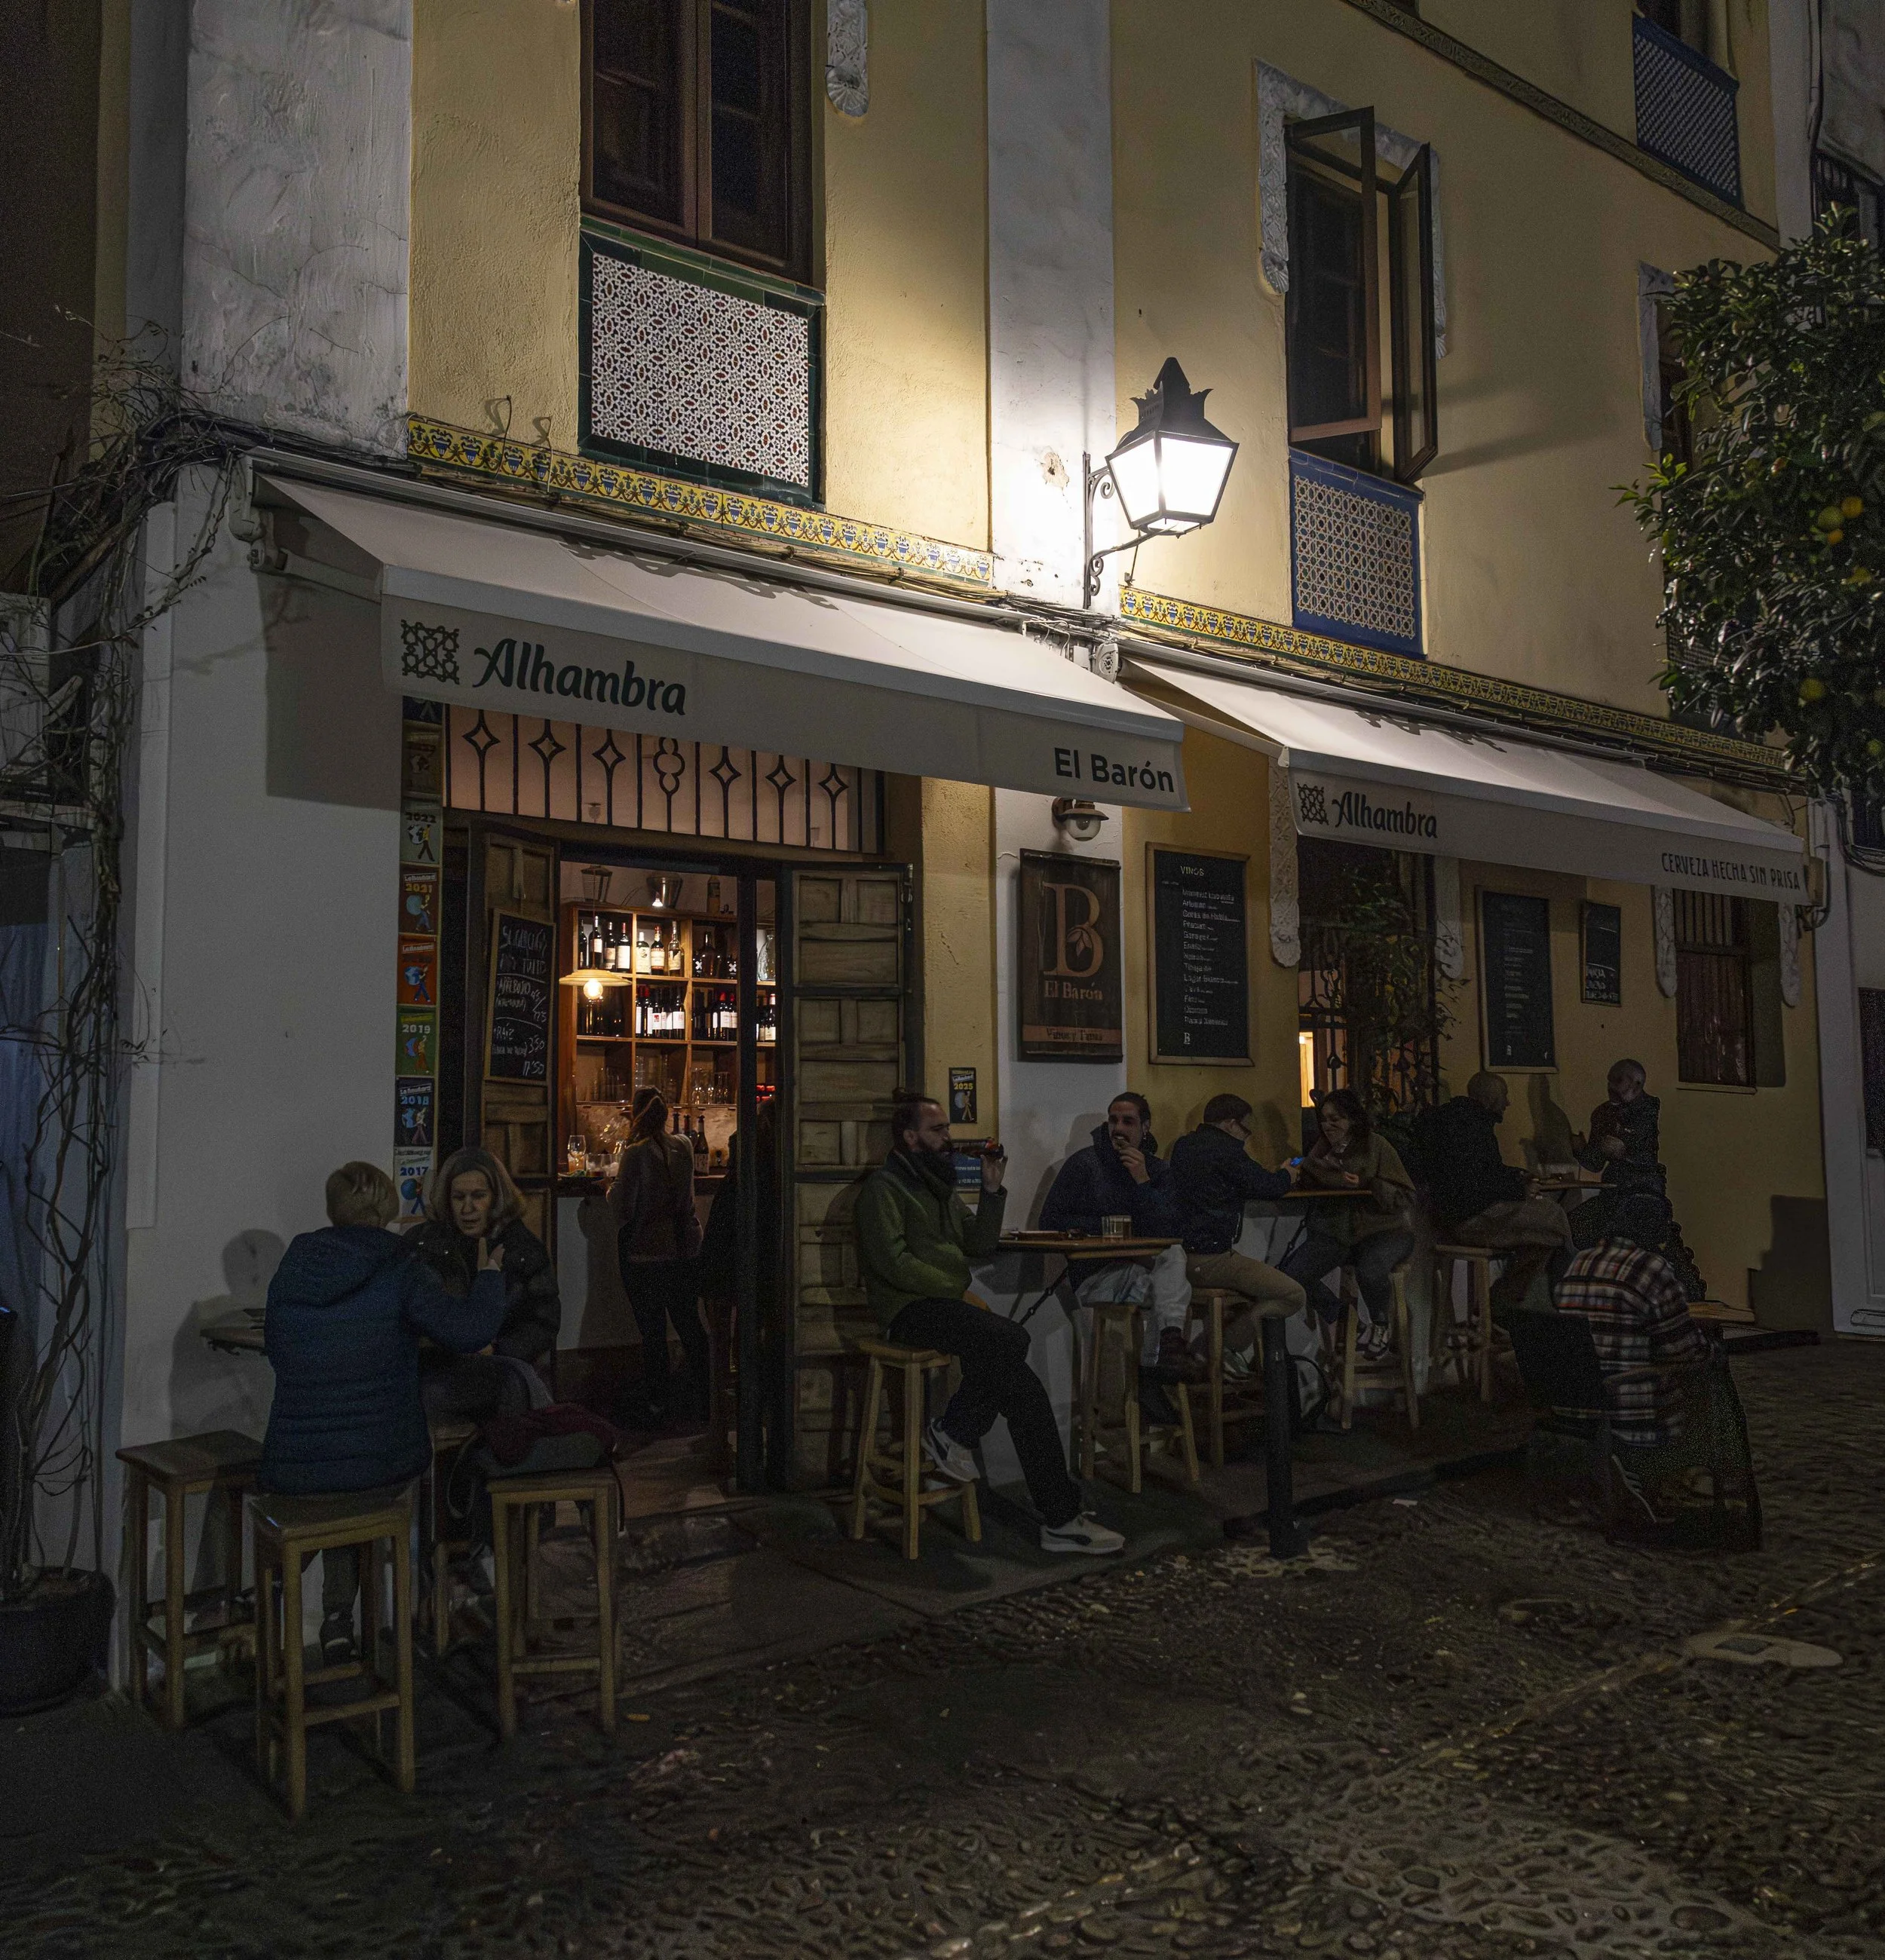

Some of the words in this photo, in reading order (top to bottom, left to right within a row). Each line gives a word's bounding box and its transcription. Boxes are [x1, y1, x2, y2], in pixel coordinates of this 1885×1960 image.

[473, 639, 685, 715] Alhambra
[1054, 747, 1080, 779] El
[1090, 754, 1174, 792] Barón
[404, 811, 437, 823] 2022
[1332, 792, 1438, 838] Alhambra
[1180, 865, 1205, 876] VINOS
[1661, 853, 1709, 877] CERVEZA
[1711, 859, 1748, 882] HECHA
[1749, 865, 1767, 885] SIN
[1770, 868, 1800, 890] PRISA
[404, 883, 433, 893] 2021
[1044, 980, 1059, 998] El
[1062, 982, 1103, 1001] Barón
[402, 1024, 431, 1034] 2019
[953, 1082, 974, 1090] 2025
[400, 1095, 429, 1106] 2018
[400, 1166, 429, 1176] 2017
